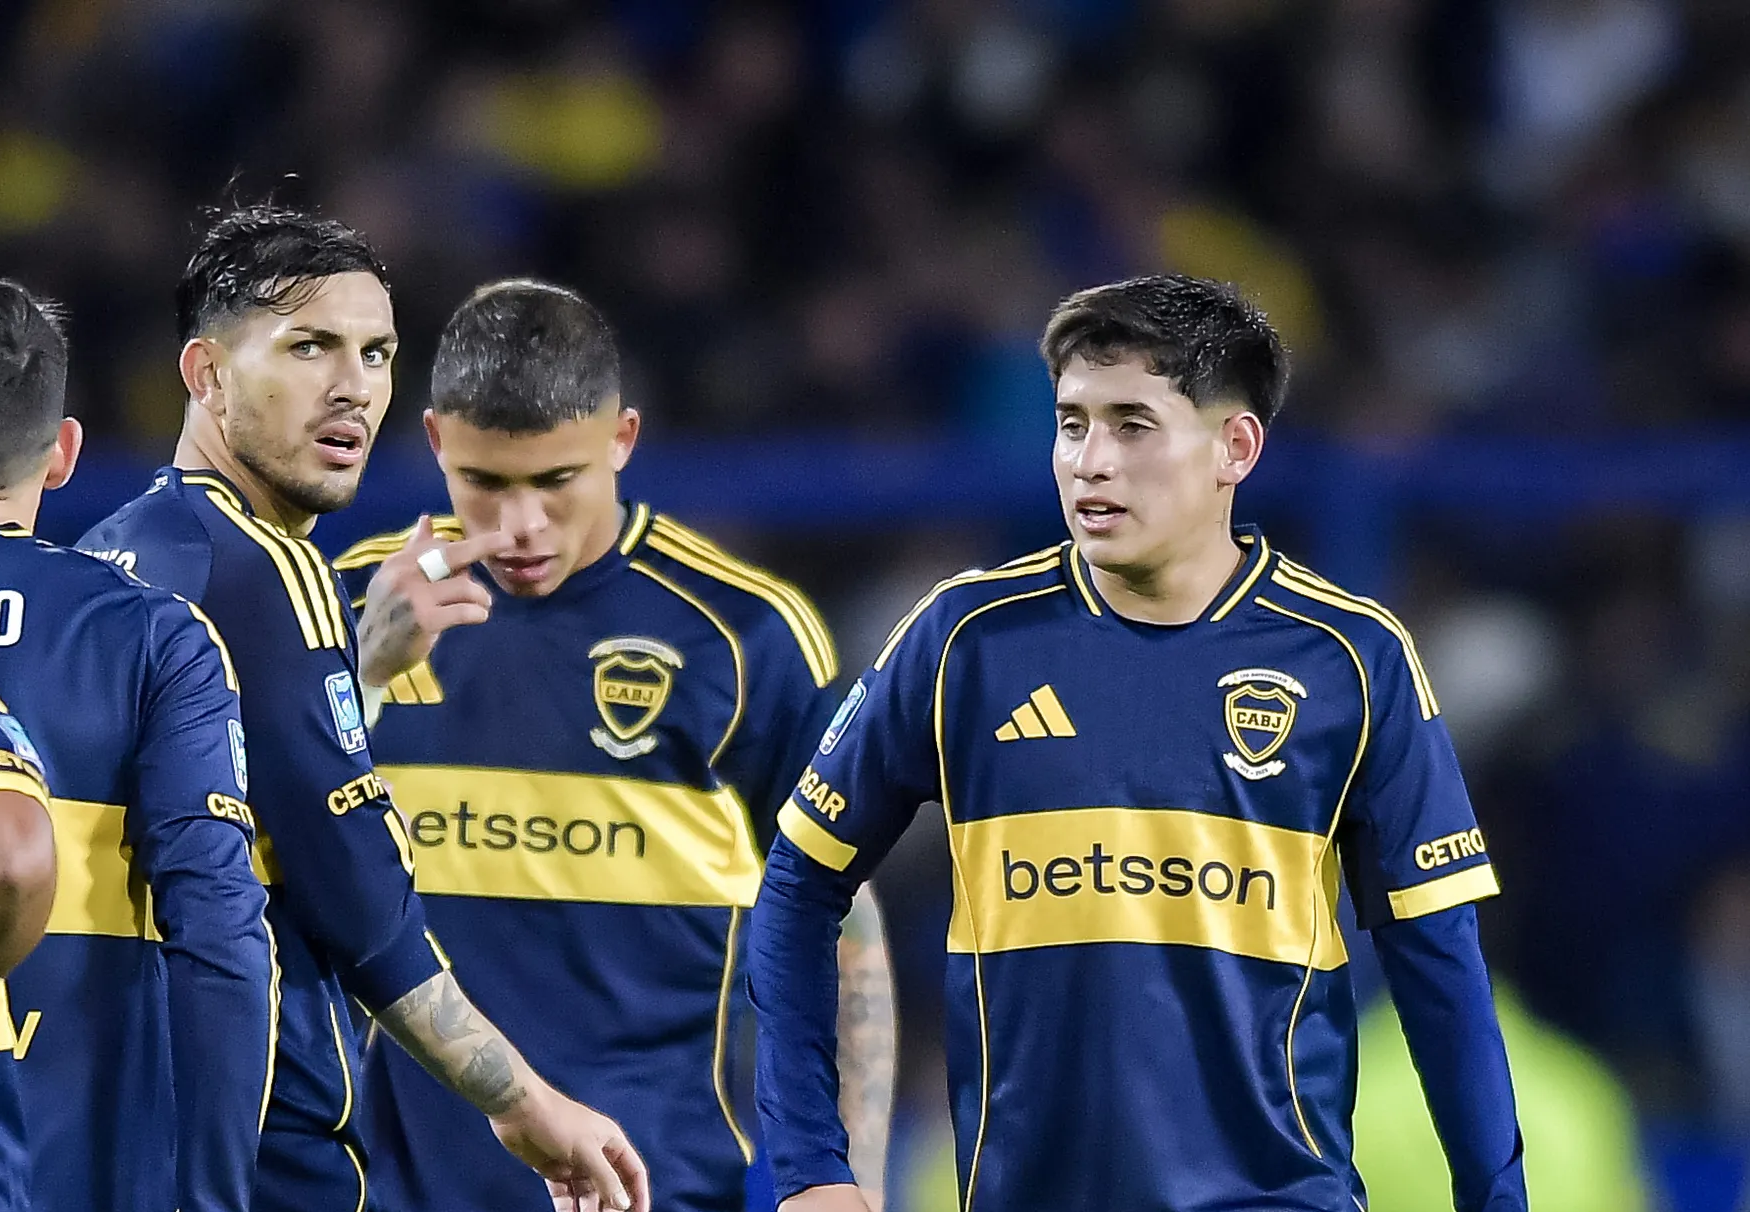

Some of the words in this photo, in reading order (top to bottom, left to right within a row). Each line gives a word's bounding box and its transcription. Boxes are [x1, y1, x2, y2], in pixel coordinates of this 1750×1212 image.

[1237, 711, 1282, 729] CABJ
[410, 800, 646, 858] etsson
[1415, 828, 1486, 871] CETRO
[1001, 842, 1275, 910] betsson
